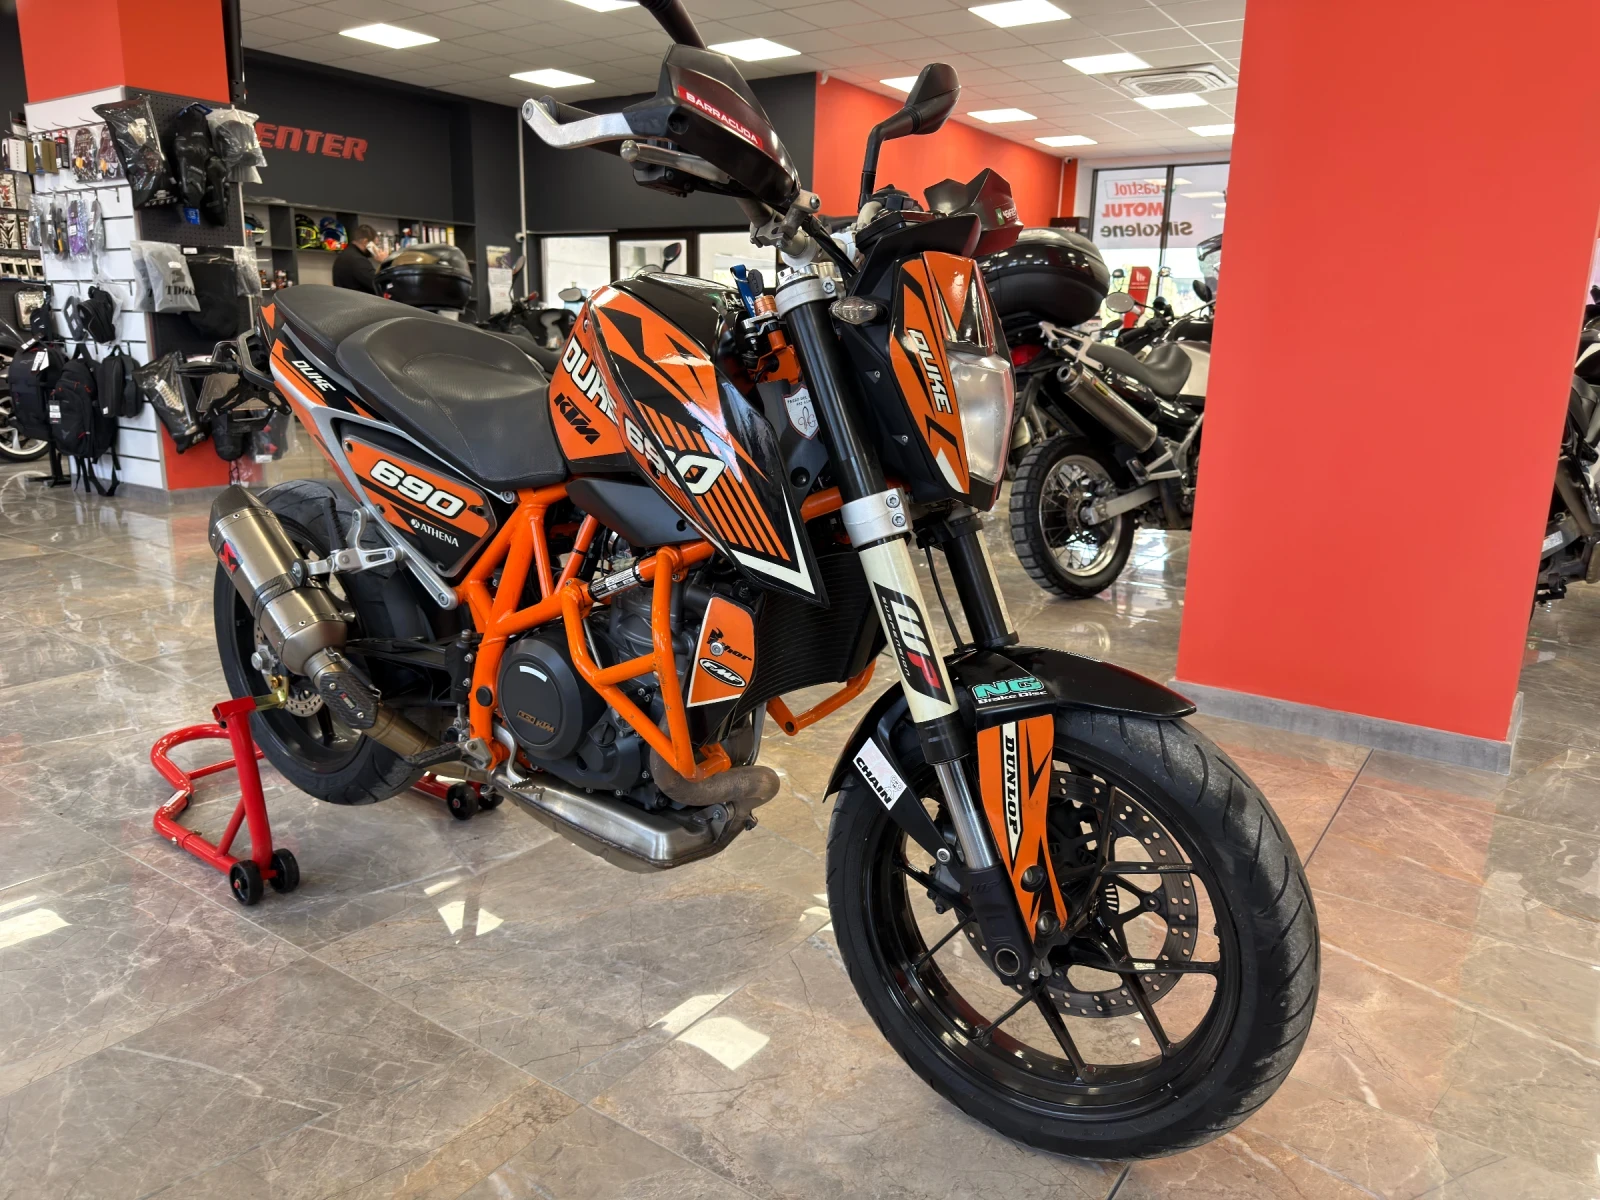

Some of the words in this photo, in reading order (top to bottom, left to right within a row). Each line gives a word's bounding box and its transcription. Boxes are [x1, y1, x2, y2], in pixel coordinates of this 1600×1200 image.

[255, 122, 368, 161] ENTER
[686, 92, 758, 144] BARRACUDA
[291, 360, 336, 392] DUKE
[562, 336, 618, 425] DUKE
[908, 327, 953, 415] DUKE
[553, 392, 600, 445] KTM
[624, 416, 726, 495] 690
[370, 459, 466, 519] 690
[420, 524, 459, 547] ATHENA
[890, 600, 941, 689] WP
[701, 661, 741, 682] FMF
[973, 677, 1043, 699] NG
[978, 694, 1018, 704] Brake
[1019, 690, 1048, 698] Disc
[856, 757, 892, 804] CHAIN
[1004, 735, 1018, 836] DUNLOP
